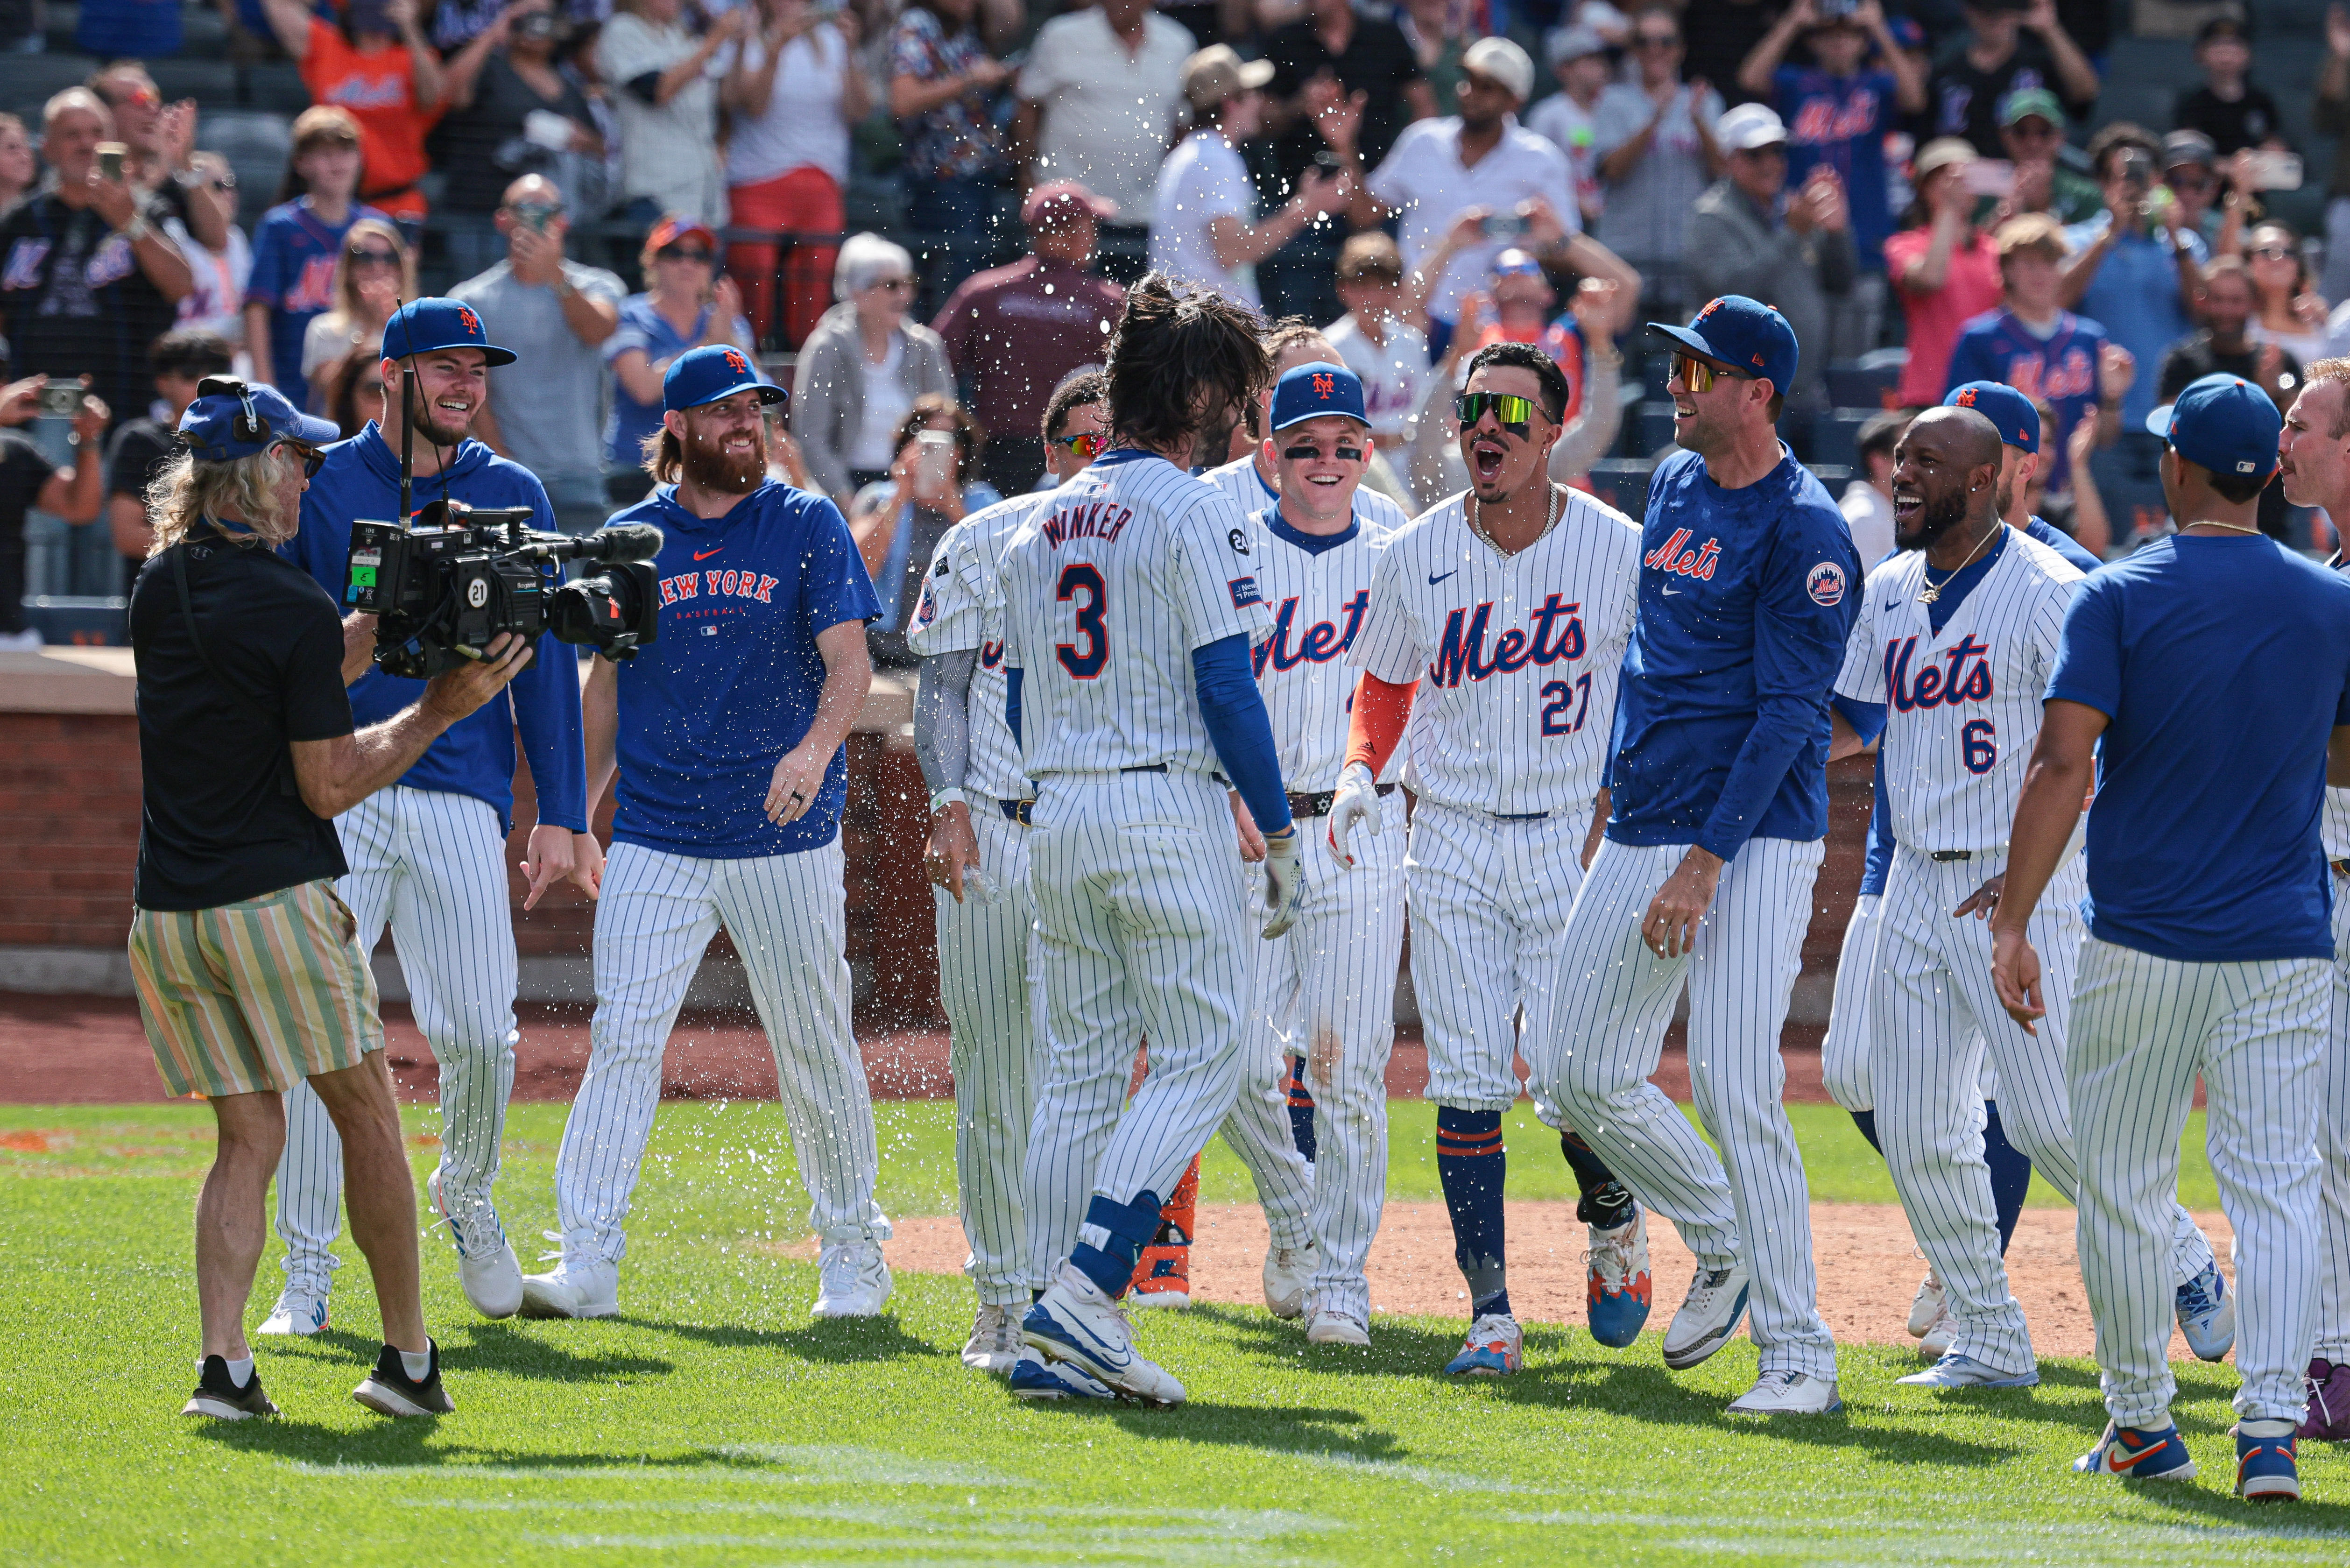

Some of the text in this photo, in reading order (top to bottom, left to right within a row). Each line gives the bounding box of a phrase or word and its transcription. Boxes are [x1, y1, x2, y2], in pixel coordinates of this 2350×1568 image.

[1312, 373, 1334, 399] NY
[1041, 502, 1133, 551] WINKER
[1232, 534, 1249, 552] 24
[1644, 527, 1722, 581] Mets
[473, 584, 484, 601] 21
[658, 569, 779, 611] EW YORK
[1815, 578, 1840, 594] Mets
[676, 606, 744, 620] BASEBALL
[1056, 563, 1109, 680] 3
[1429, 593, 1587, 689] Mets
[1884, 633, 1994, 719] Mets
[1961, 718, 1997, 775] 6
